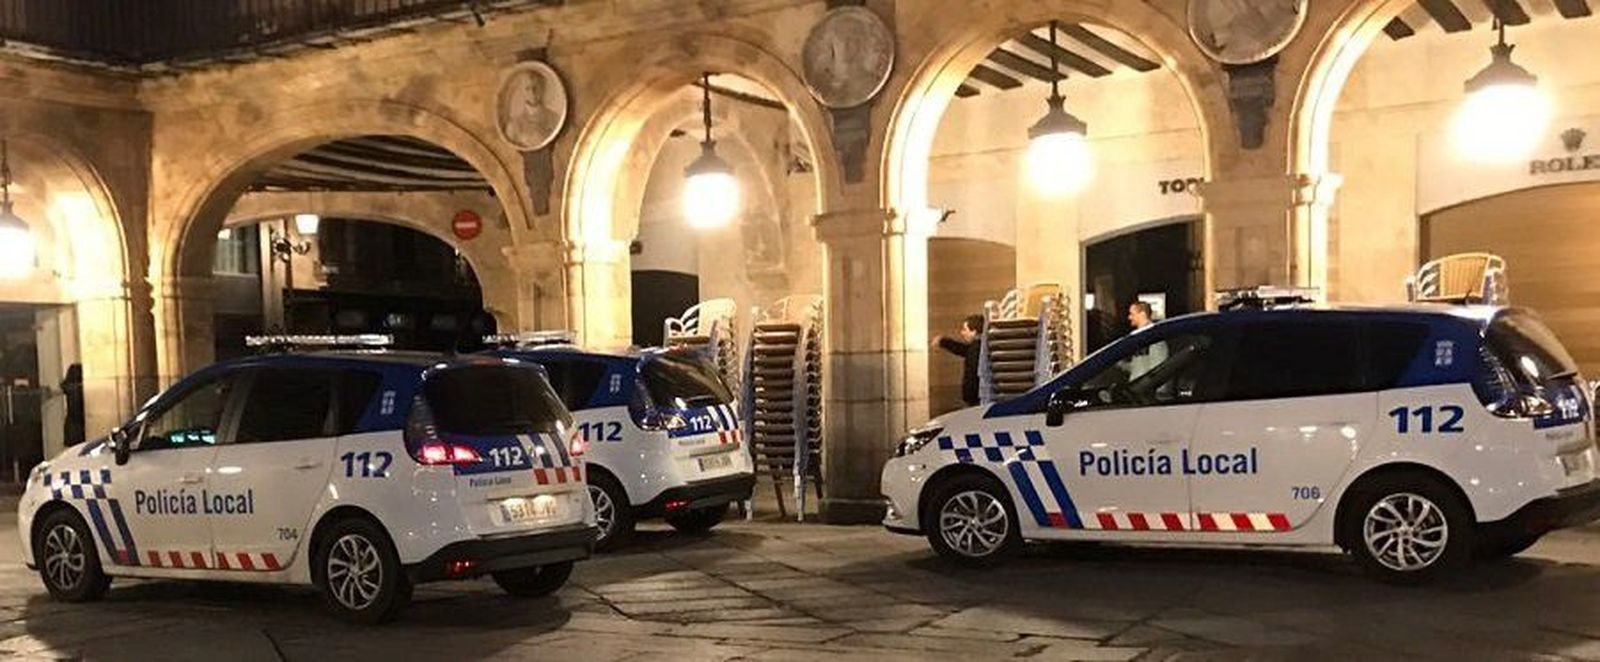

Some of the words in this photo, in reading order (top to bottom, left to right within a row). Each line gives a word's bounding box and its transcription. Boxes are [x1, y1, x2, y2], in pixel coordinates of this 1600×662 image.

[689, 416, 712, 431] 112
[1388, 405, 1464, 434] 112
[578, 421, 623, 442] 112
[340, 451, 394, 478] 112
[488, 446, 524, 467] 112
[1079, 449, 1172, 477] Policía
[1182, 447, 1258, 475] Local
[135, 488, 198, 515] Policía
[203, 489, 254, 514] Local
[1292, 486, 1320, 500] 706
[277, 528, 298, 541] 704
